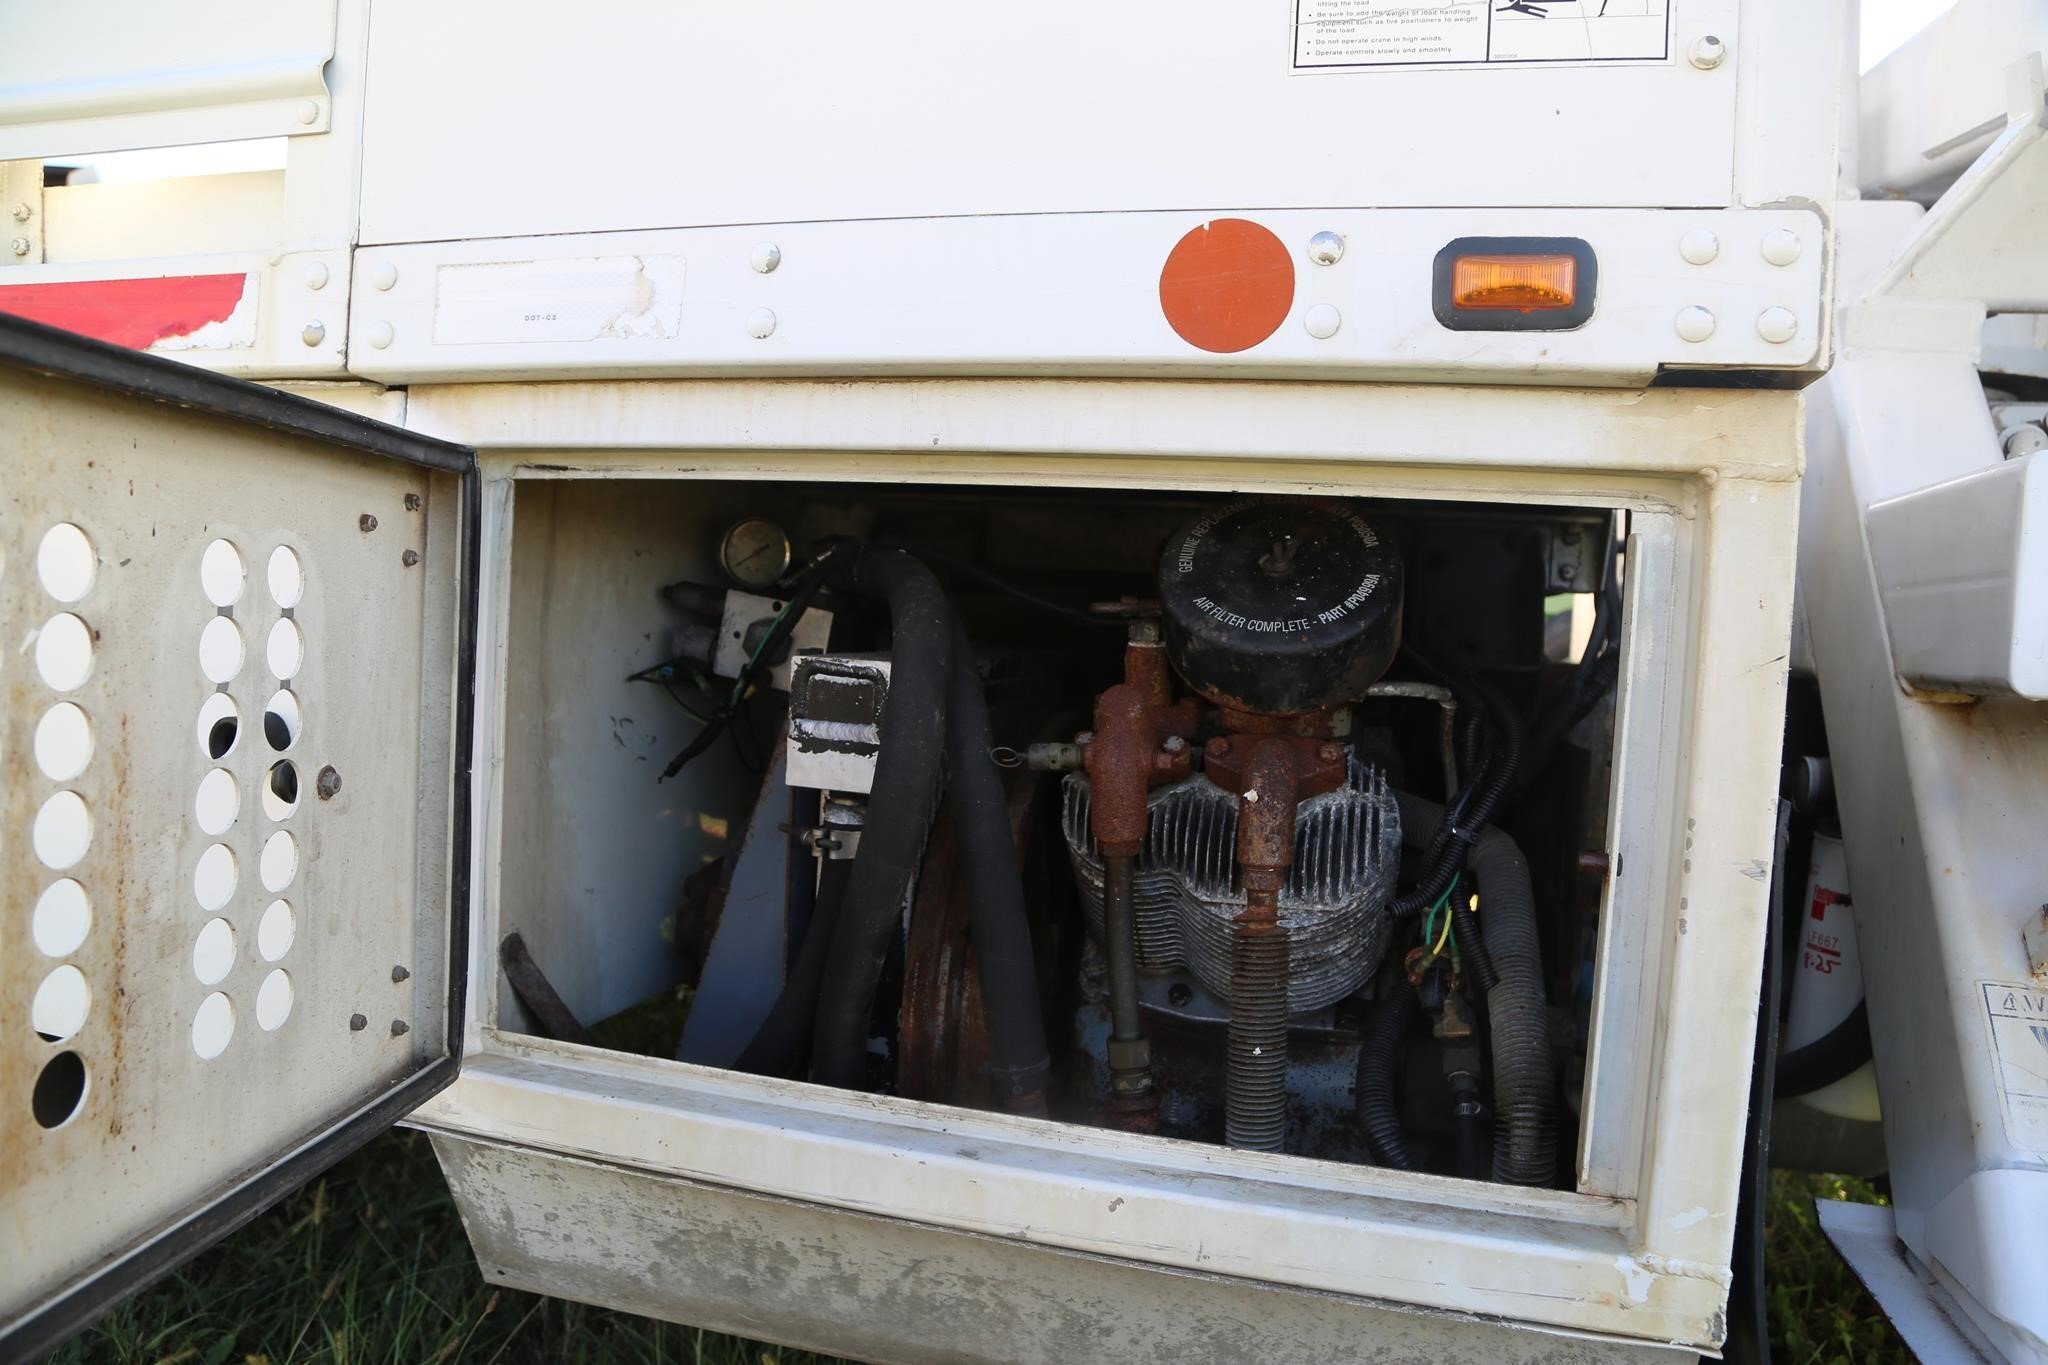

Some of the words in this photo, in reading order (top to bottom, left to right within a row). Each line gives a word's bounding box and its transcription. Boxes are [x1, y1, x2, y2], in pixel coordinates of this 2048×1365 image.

[1386, 10, 1409, 18] weight
[1178, 535, 1200, 573] GENUINE
[1193, 596, 1214, 613] AIR
[1209, 606, 1245, 628] FILTER
[1247, 618, 1311, 633] COMPLETE
[1318, 604, 1348, 625] PART
[1343, 574, 1381, 610] #P04999A
